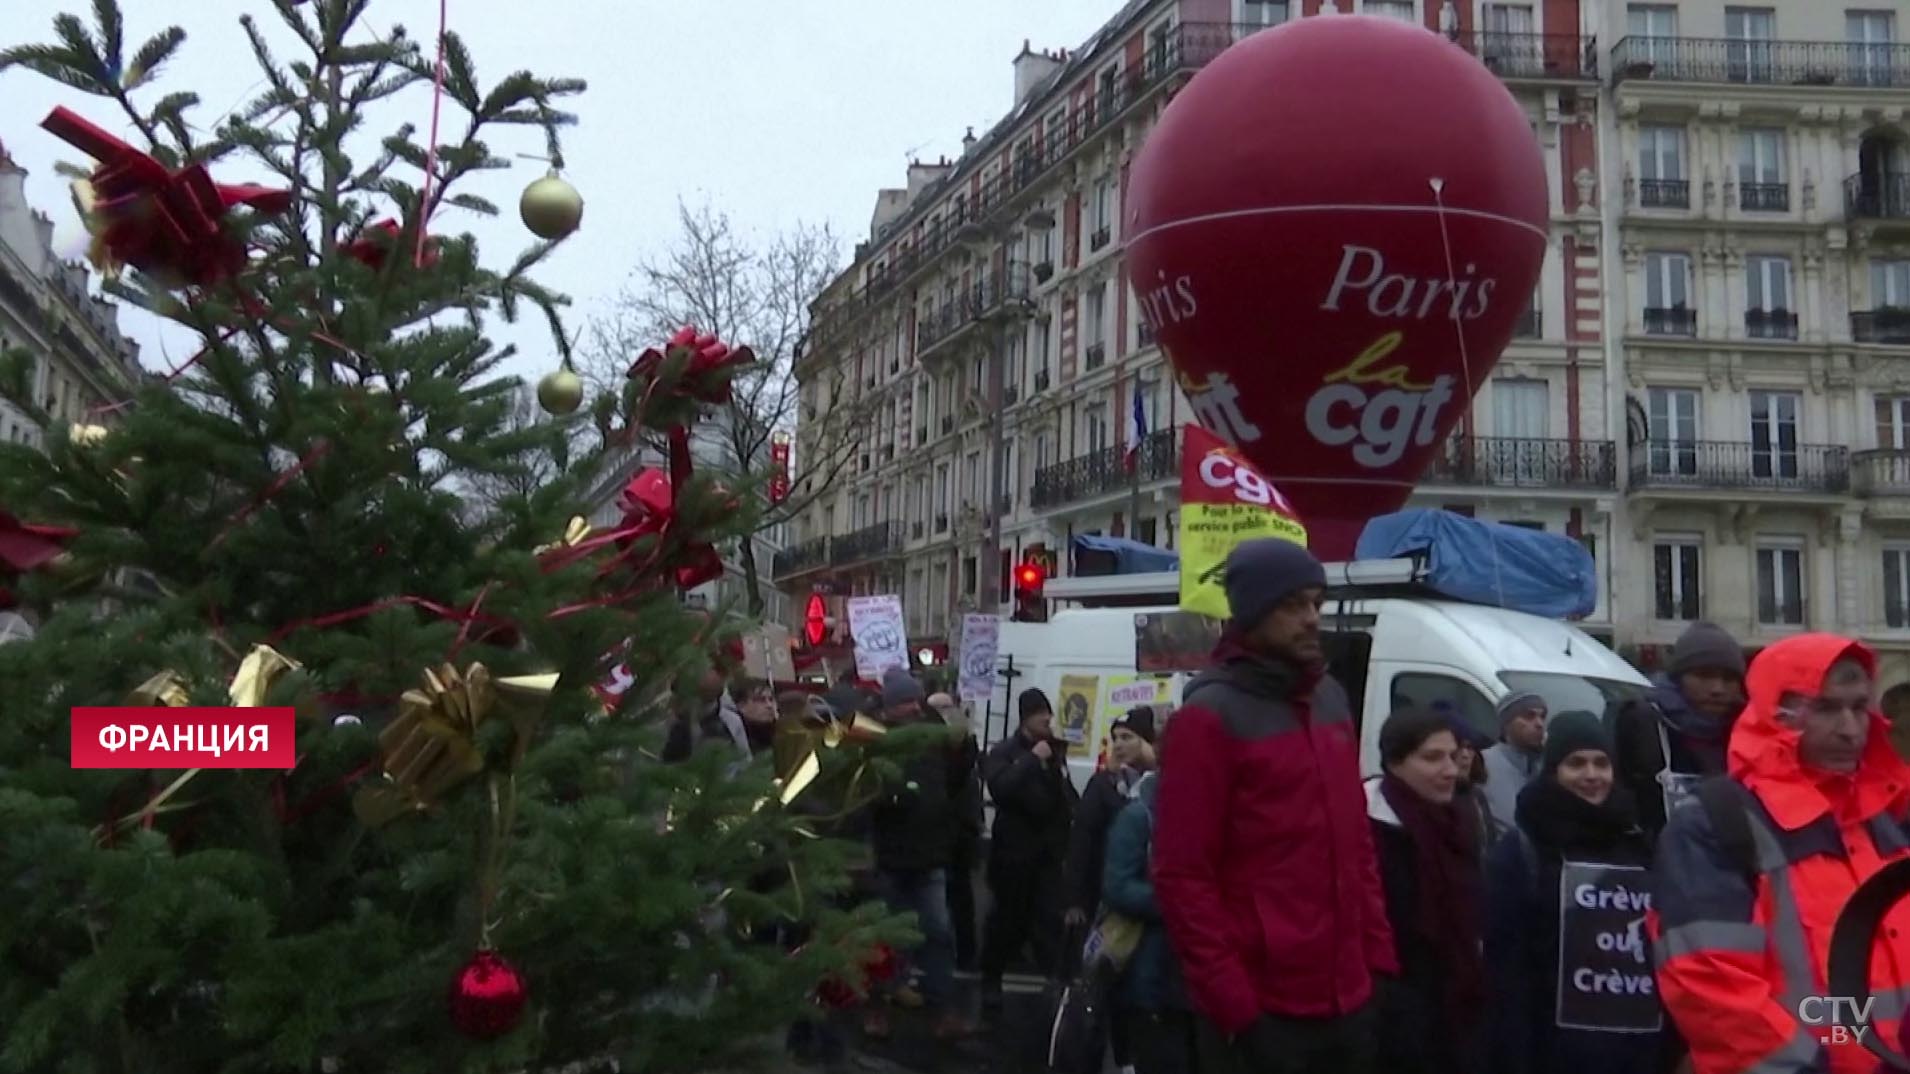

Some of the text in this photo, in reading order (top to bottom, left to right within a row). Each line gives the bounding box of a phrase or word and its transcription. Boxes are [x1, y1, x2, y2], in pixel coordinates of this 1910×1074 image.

[1319, 244, 1496, 320] Paris
[1323, 331, 1432, 391] la
[1305, 373, 1456, 468] cgt
[1187, 523, 1229, 532] service
[1232, 515, 1266, 533] public
[1573, 968, 1653, 994] Crève
